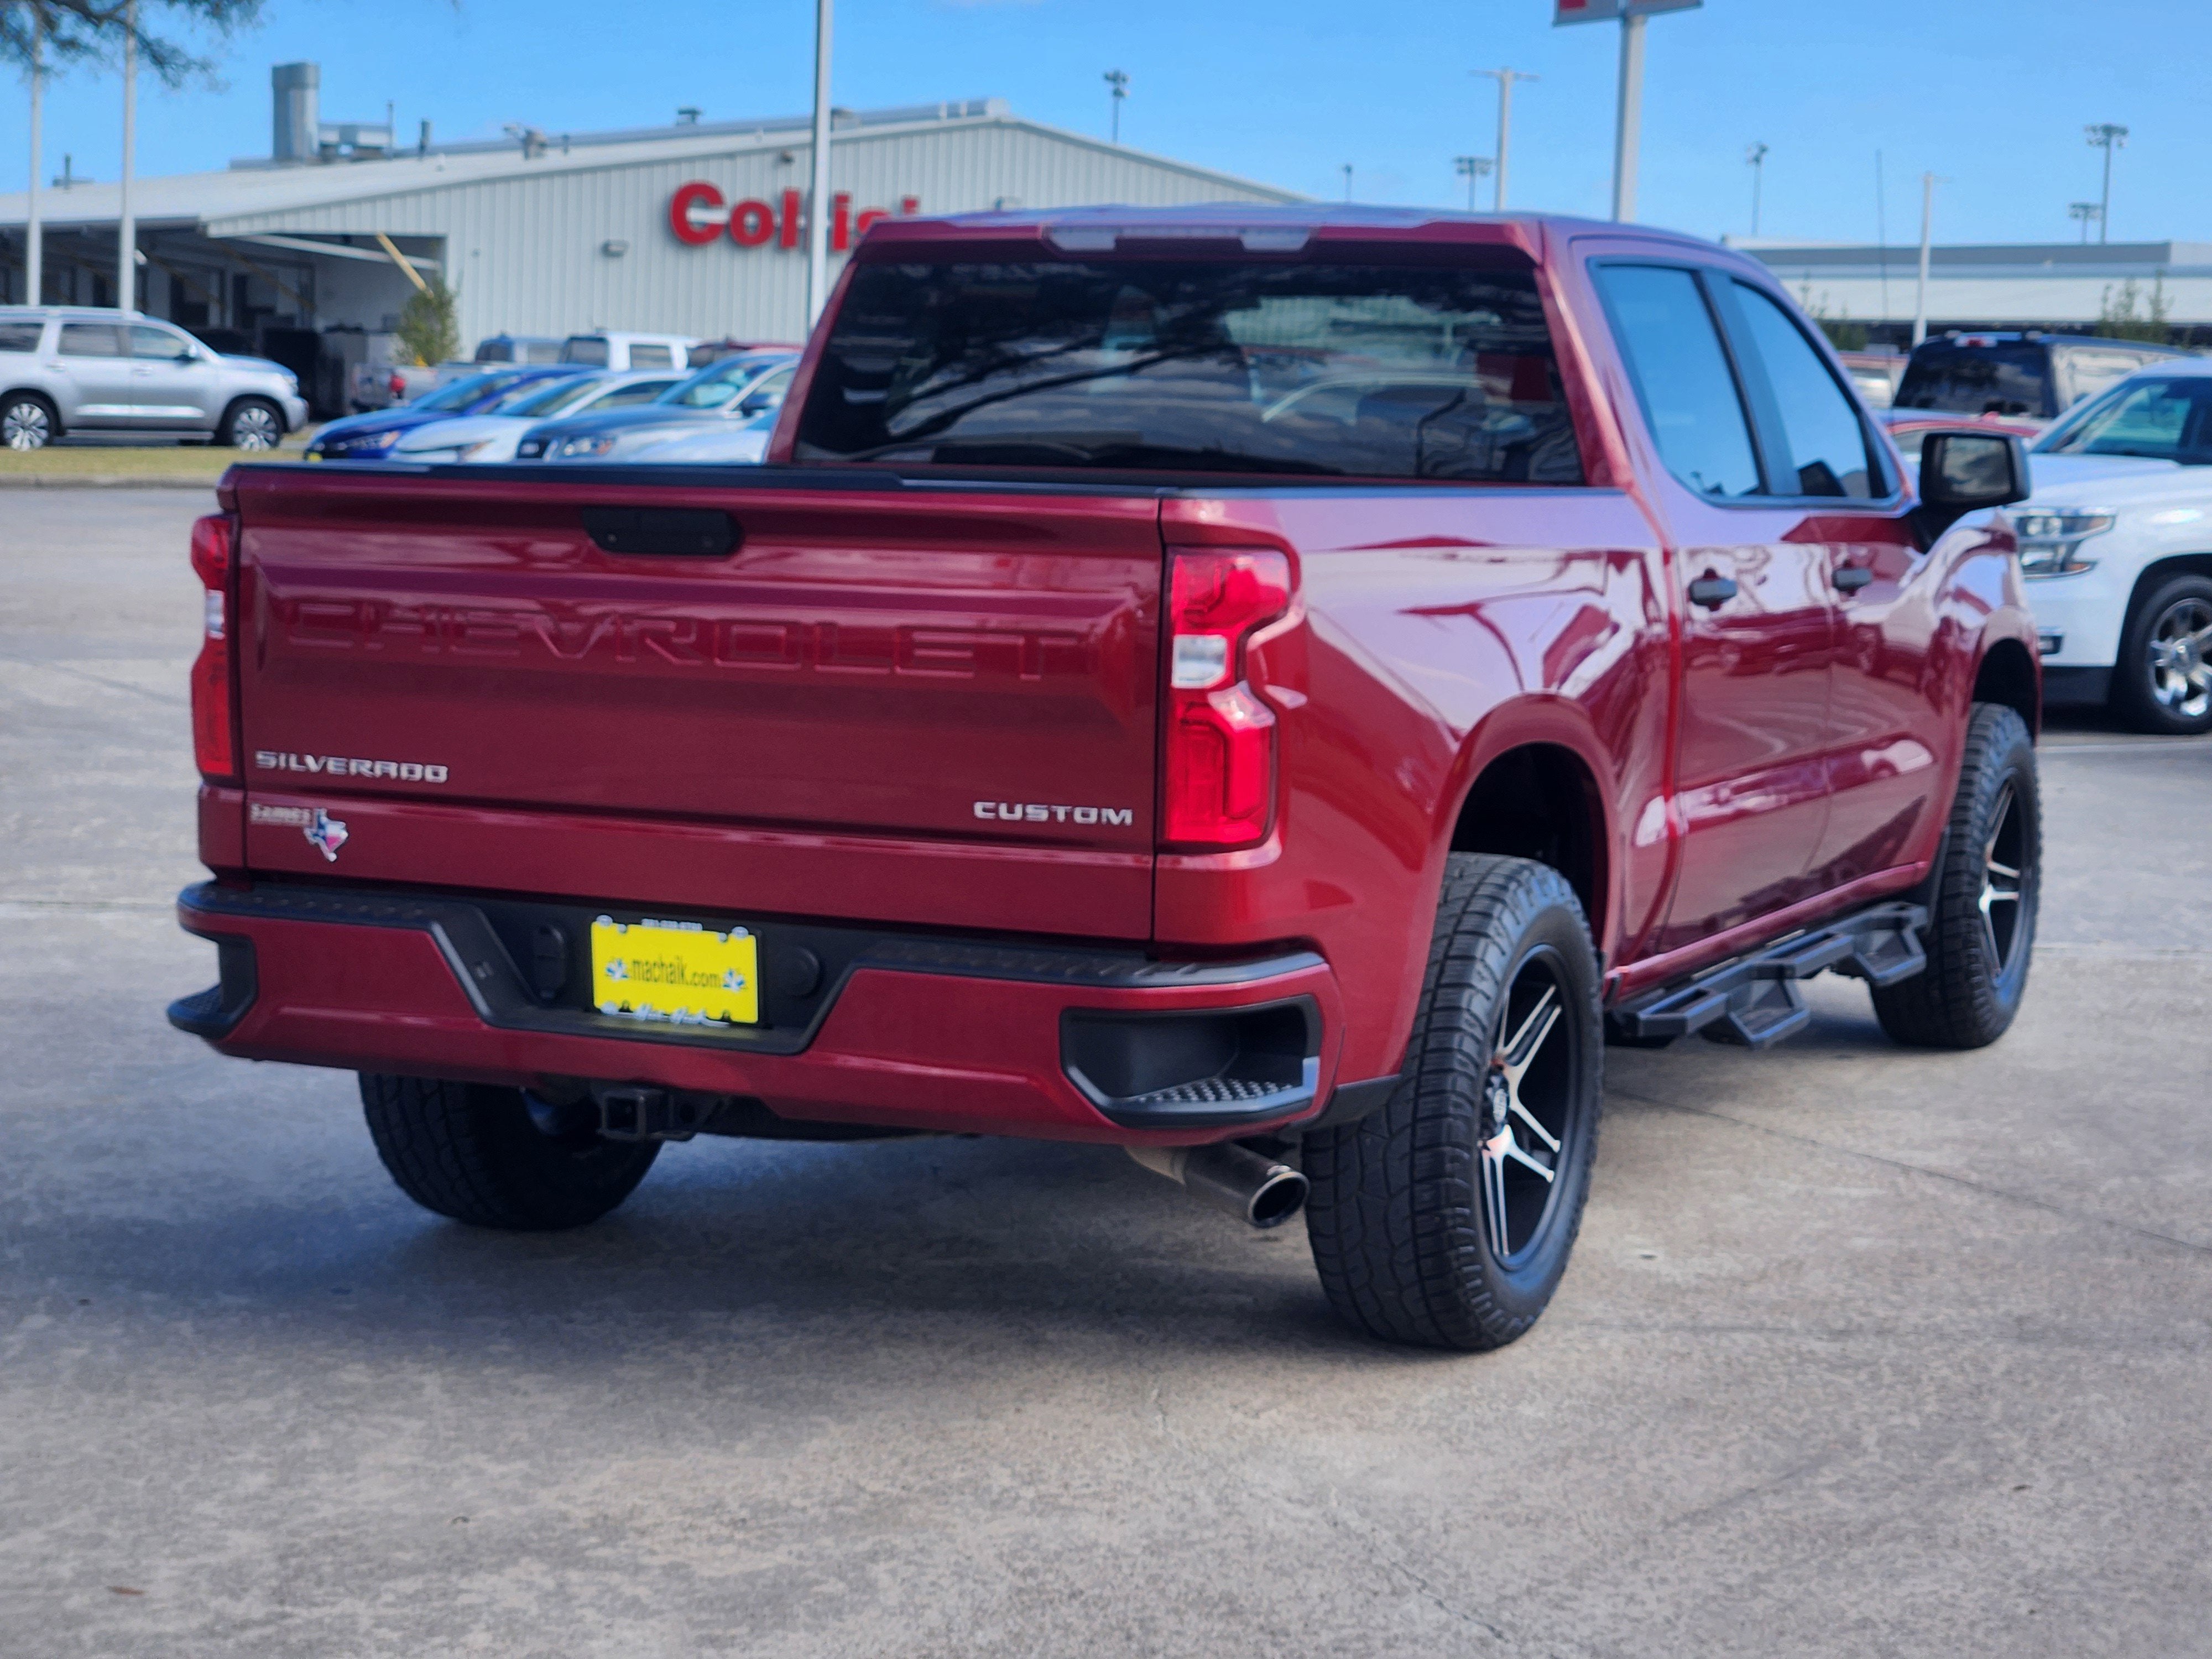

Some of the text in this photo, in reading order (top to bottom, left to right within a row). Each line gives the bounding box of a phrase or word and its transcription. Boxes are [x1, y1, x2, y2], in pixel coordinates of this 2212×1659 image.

[286, 601, 1091, 681] CHEVROLET
[255, 750, 448, 783] SILVERADO
[973, 801, 1133, 826] CUSTOM
